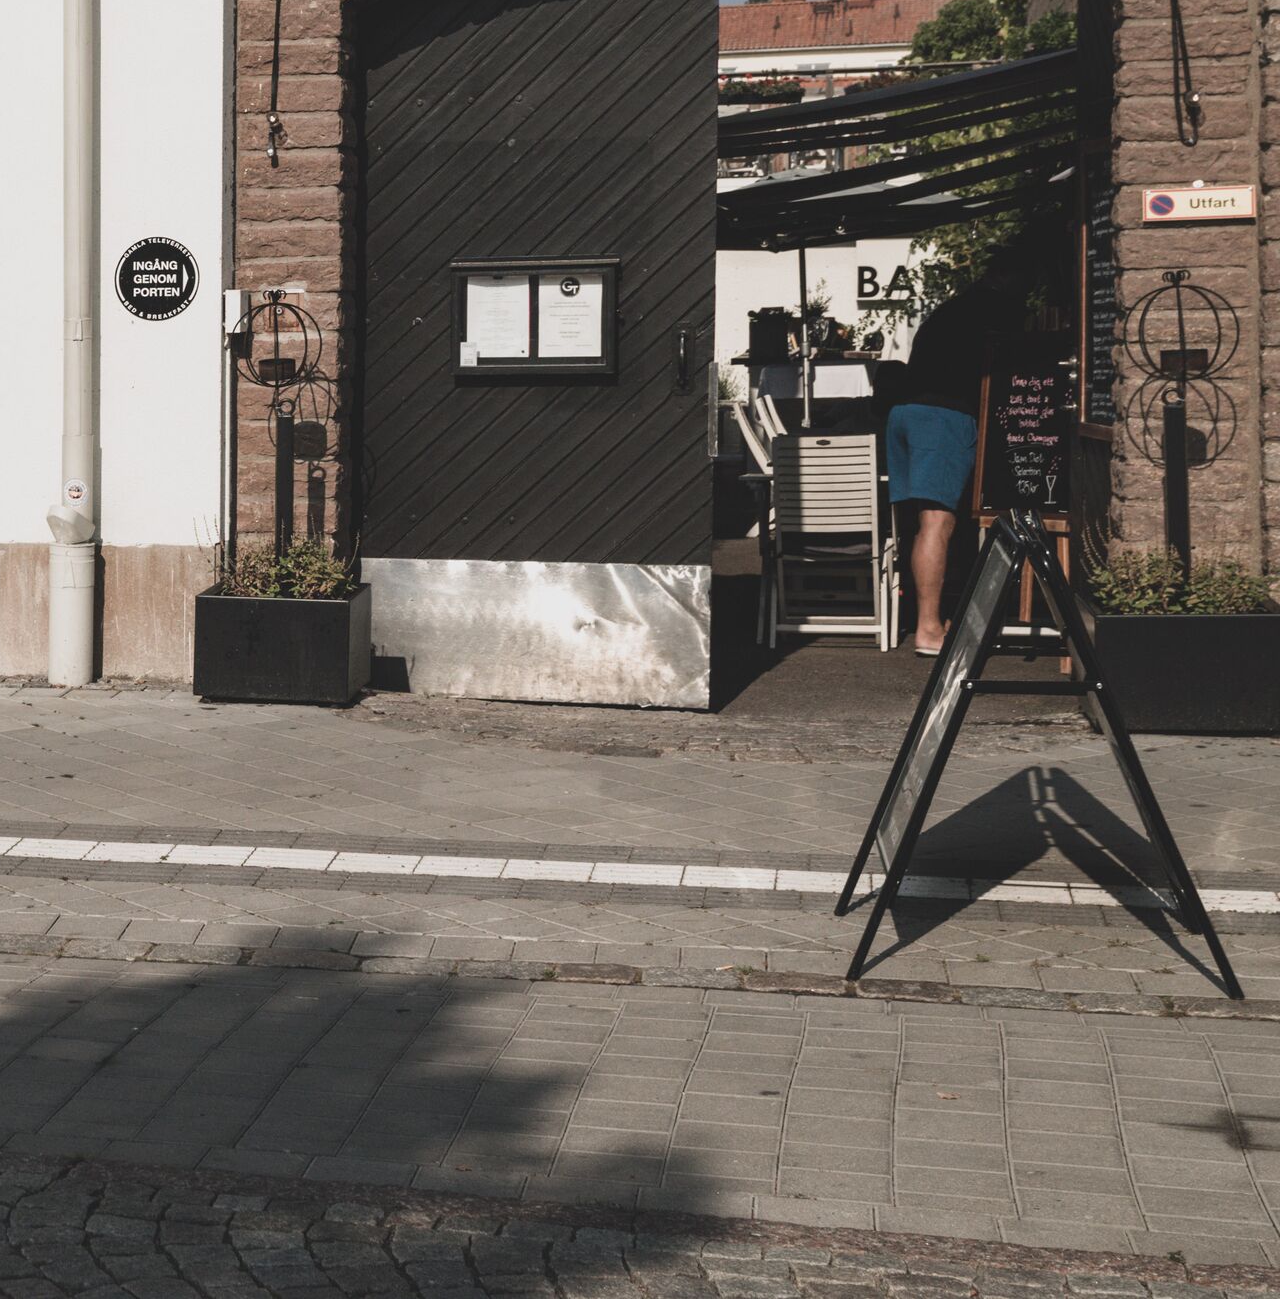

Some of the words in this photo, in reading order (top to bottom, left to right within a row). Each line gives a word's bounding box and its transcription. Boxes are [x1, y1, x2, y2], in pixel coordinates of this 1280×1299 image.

[1189, 197, 1237, 209] Utfart
[123, 240, 146, 259] GAMLA
[147, 237, 191, 257] TELEVERKET
[133, 258, 178, 270] INGÅNG
[133, 273, 177, 285] GENOM
[858, 265, 934, 297] BA
[133, 287, 180, 297] PORTEN
[561, 281, 579, 295] GT
[123, 300, 138, 313] BED
[146, 299, 190, 320] BREAKFAST
